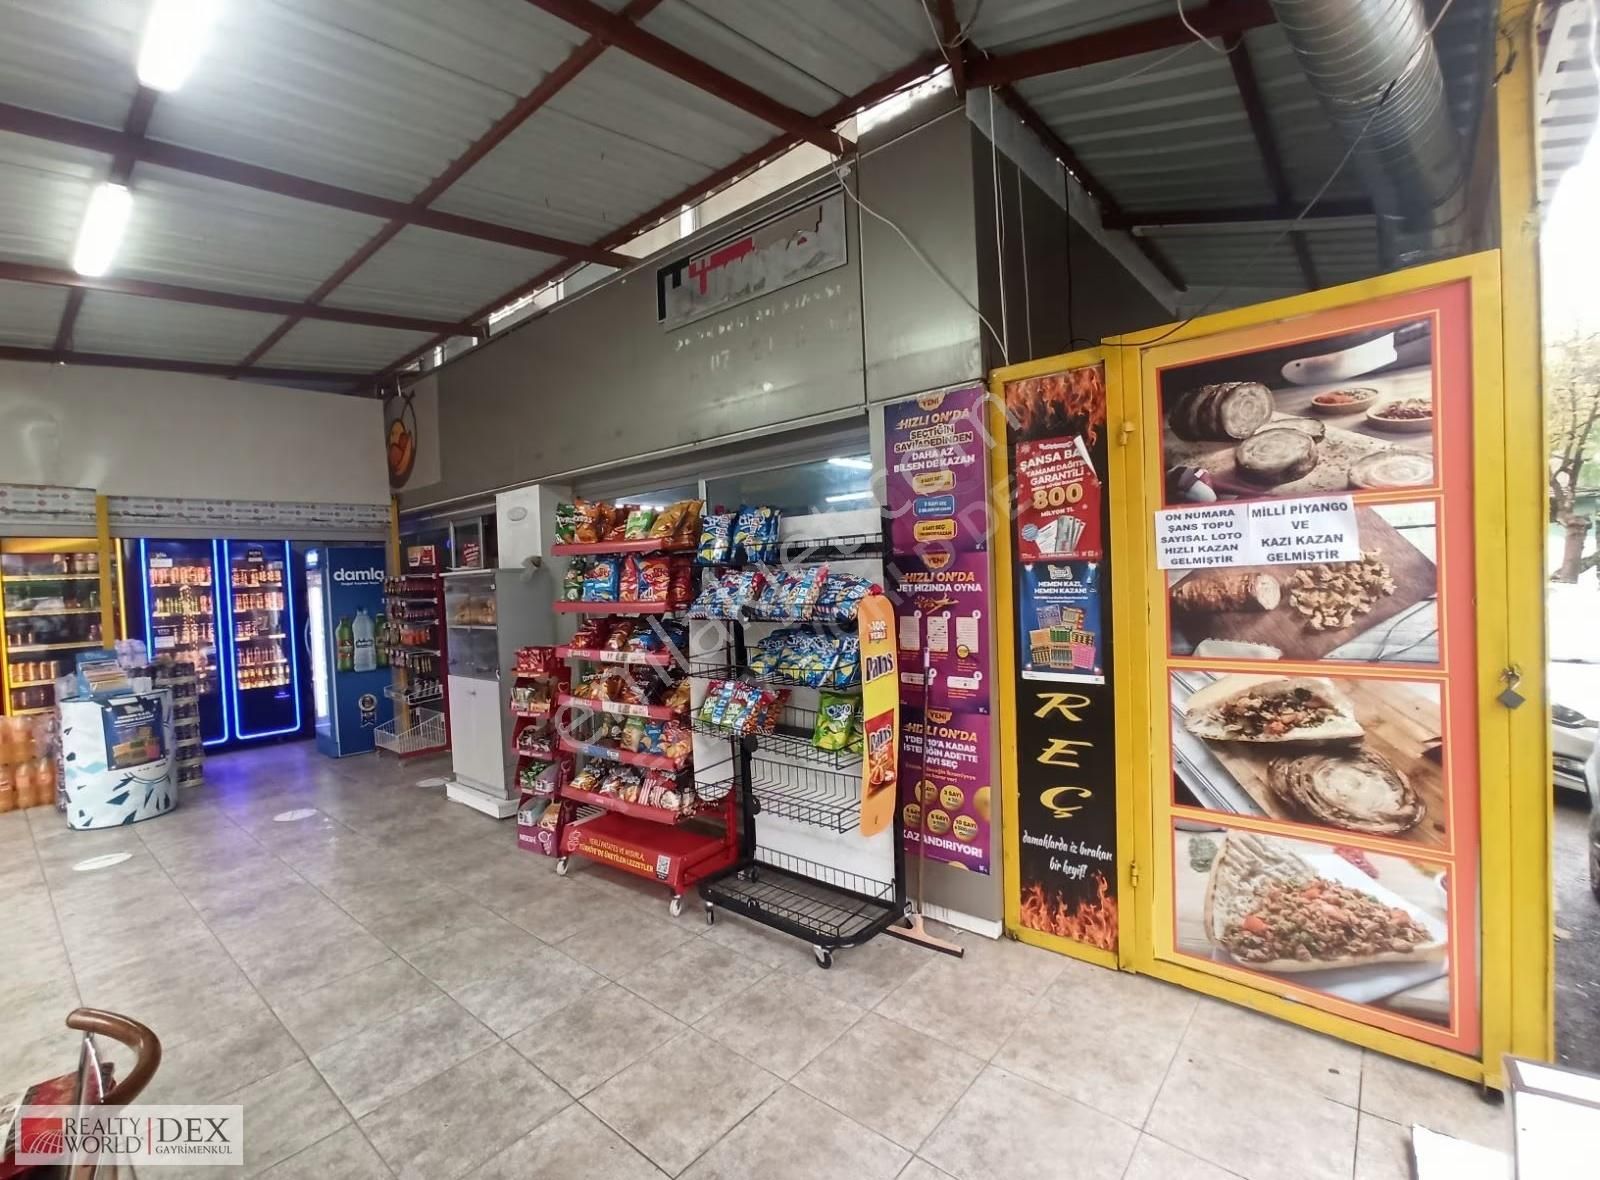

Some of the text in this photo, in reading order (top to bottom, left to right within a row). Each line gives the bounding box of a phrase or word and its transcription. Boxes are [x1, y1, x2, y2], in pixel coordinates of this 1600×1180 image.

[898, 408, 970, 430] HIZLI ON'DA
[911, 425, 954, 439] SEÇTİĞİN
[895, 432, 972, 452] SAYI ADEDİNDEN
[912, 448, 954, 460] DAHA AZ
[1020, 448, 1081, 473] ŞANSA BA
[894, 454, 975, 472] BİLSEN DE KAZAN
[1026, 466, 1056, 477] TAMAMI
[1030, 467, 1084, 486] GARANTİLİ
[1033, 482, 1084, 509] 800
[1041, 508, 1065, 517] MİLYON
[1184, 509, 1235, 520] NUMARA
[1251, 502, 1348, 518] MİLLİ PİYANGO
[1168, 521, 1233, 533] ŞANS TOPU
[1291, 520, 1309, 530] VE
[1161, 532, 1242, 544] SAYISAL LOTO
[1261, 534, 1343, 547] KAZI KAZAN
[1165, 544, 1239, 555] HIZLI KAZAN
[1266, 549, 1339, 562] GELMİŞTİR
[1170, 555, 1233, 566] GELMİŞTİR
[333, 567, 384, 582] damla
[904, 571, 975, 582] HIZLI ON'DA
[896, 584, 982, 592] JET HIZINDA OYNA
[938, 728, 978, 743] ON'DA
[928, 739, 945, 749] 10'A
[945, 741, 977, 754] KADAR
[943, 751, 978, 763] ADETTE
[1034, 692, 1094, 819] REÇ
[941, 758, 959, 769] SEÇ
[1022, 829, 1113, 861] damaklarda iz bırakan
[1049, 856, 1062, 870] bir
